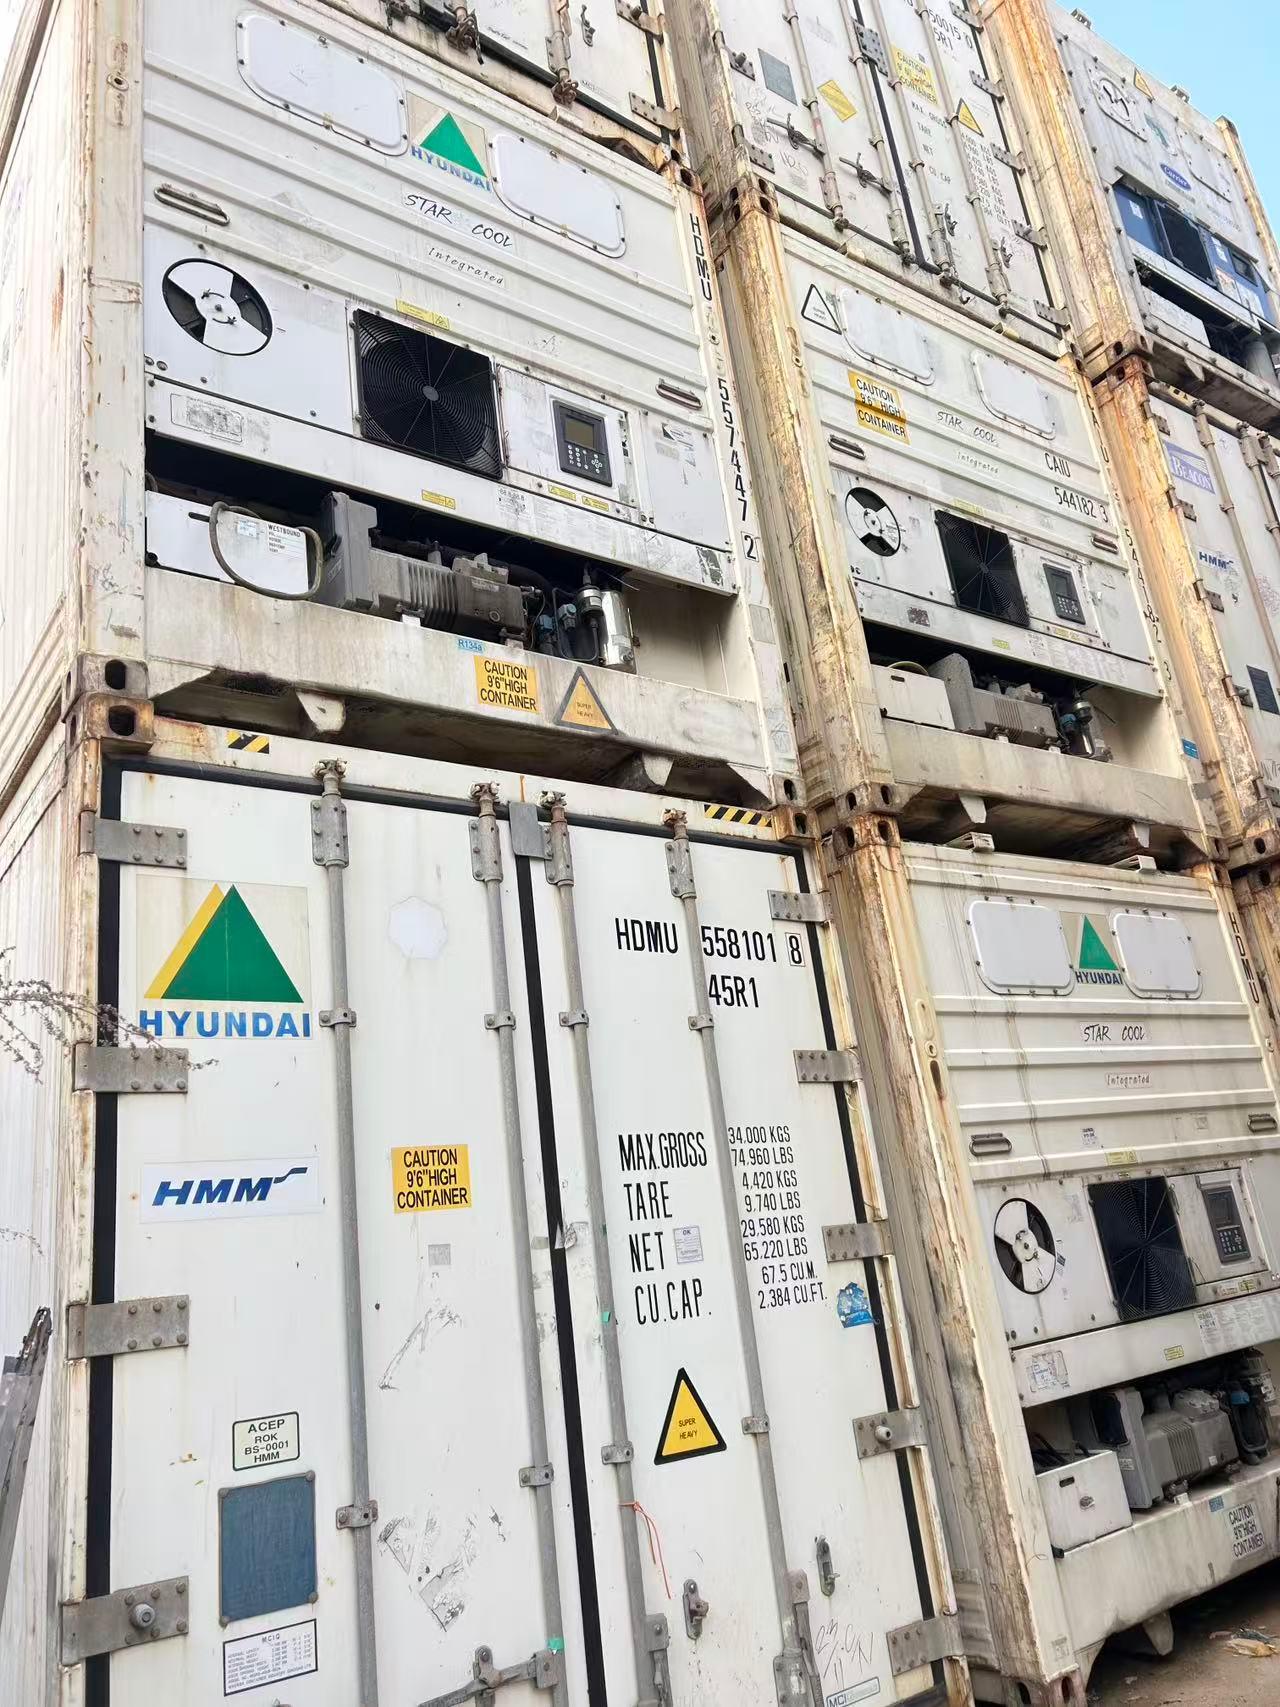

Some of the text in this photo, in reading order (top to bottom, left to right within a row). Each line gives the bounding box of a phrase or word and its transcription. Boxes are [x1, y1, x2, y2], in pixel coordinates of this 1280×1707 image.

[899, 75, 937, 105] CONTAINER
[410, 144, 493, 192] HYUNDAI
[1164, 166, 1187, 187] Carrier
[404, 194, 513, 248] STAR COOL
[428, 247, 504, 286] Integrated
[689, 212, 713, 302] HDMU
[856, 378, 894, 403] CAUTION
[880, 400, 901, 418] HIGH
[857, 409, 906, 438] CONTAINER
[937, 410, 996, 444] STAR COOL
[1086, 394, 1110, 464] CAIU
[717, 377, 748, 522] 557447
[1044, 452, 1071, 478] CAIU
[1171, 455, 1211, 490] BEACON
[1054, 486, 1109, 523] 544182 3
[267, 523, 301, 538] WESTBOUND
[744, 534, 757, 560] 2
[1199, 551, 1228, 570] HMM
[1125, 528, 1162, 643] 544182
[458, 639, 483, 652] R134a
[484, 659, 528, 681] CAUTION
[1163, 661, 1172, 681] 3
[480, 688, 537, 711] CONTAINER
[576, 701, 592, 709] SUPER
[576, 709, 594, 718] HEAVY
[615, 917, 803, 965] HDMU 558101 8
[1228, 911, 1260, 1004] HDMU
[1075, 971, 1123, 985] HYUNDAI
[708, 974, 760, 1008] 45R1
[139, 1009, 311, 1038] HYUNDAI
[1084, 1023, 1145, 1042] STAR COOL
[1107, 1074, 1150, 1087] Integrated
[403, 1148, 458, 1169] CAUTION
[618, 1131, 708, 1172] MAX.GROSS
[769, 1125, 791, 1143] KGS
[772, 1146, 794, 1165] LBS
[151, 1170, 290, 1207] HMM
[396, 1186, 468, 1210] CONTAINER
[624, 1180, 673, 1221] TARE
[776, 1170, 798, 1188] KGS
[779, 1191, 801, 1210] LBS
[628, 1231, 665, 1273] NET
[782, 1215, 805, 1234] KGS
[786, 1237, 808, 1257] LBS
[761, 1264, 788, 1284] 67.5
[247, 1418, 285, 1434] ACEP
[678, 1417, 696, 1428] SUPER
[254, 1432, 278, 1444] ROK
[679, 1429, 699, 1440] HEAVY
[244, 1440, 290, 1456] BS-0001
[253, 1451, 280, 1464] HMM
[1228, 1503, 1254, 1525] CAUTION
[1232, 1532, 1265, 1557] CONTAINER
